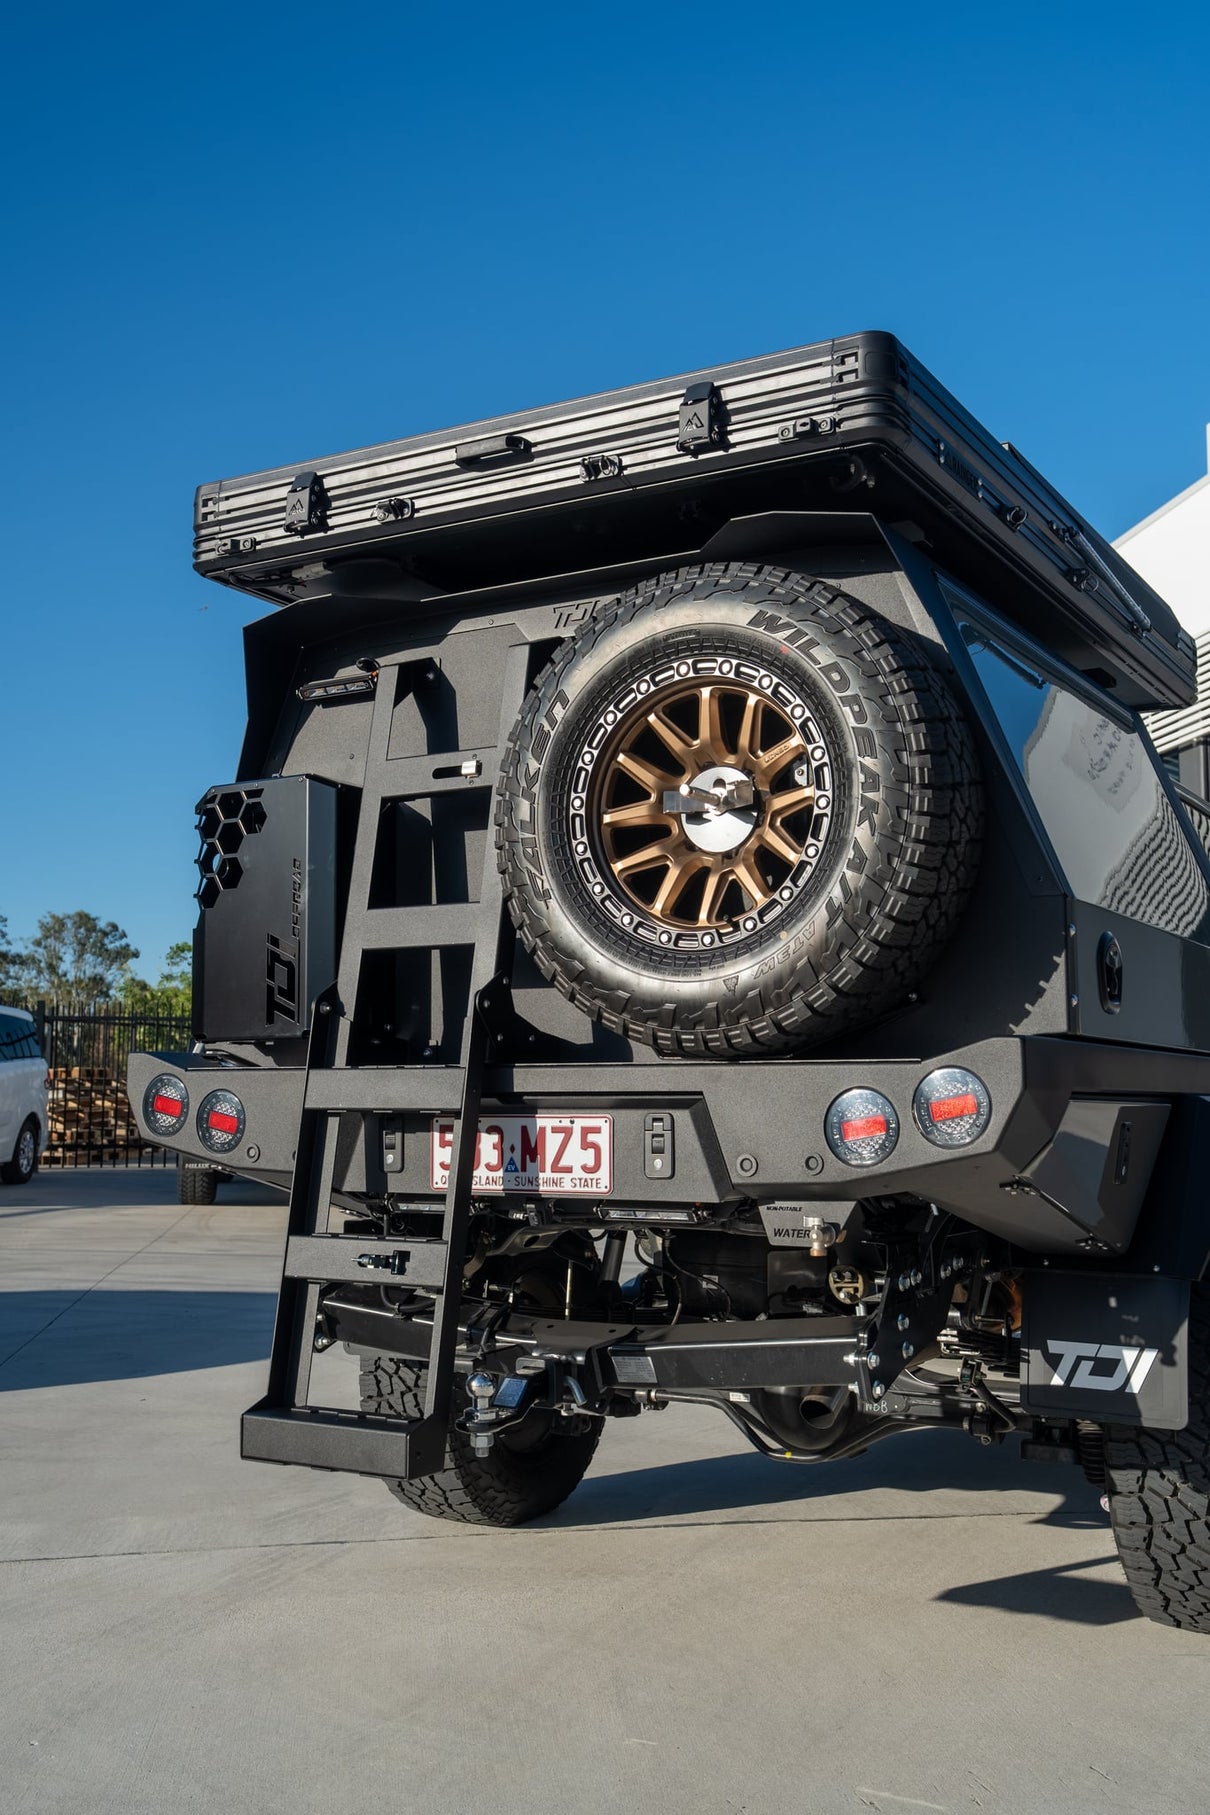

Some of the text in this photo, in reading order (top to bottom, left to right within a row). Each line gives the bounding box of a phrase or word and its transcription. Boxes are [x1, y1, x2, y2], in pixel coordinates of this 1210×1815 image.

[743, 609, 880, 837] WILDPEAK
[519, 688, 570, 901] FALKEN
[752, 920, 817, 980] AT3W
[520, 1125, 602, 1174] MZ5
[440, 1174, 602, 1189] QSLAND SUNSHINE STATE
[773, 1227, 811, 1239] WATER
[1046, 1339, 1159, 1394] TDI
